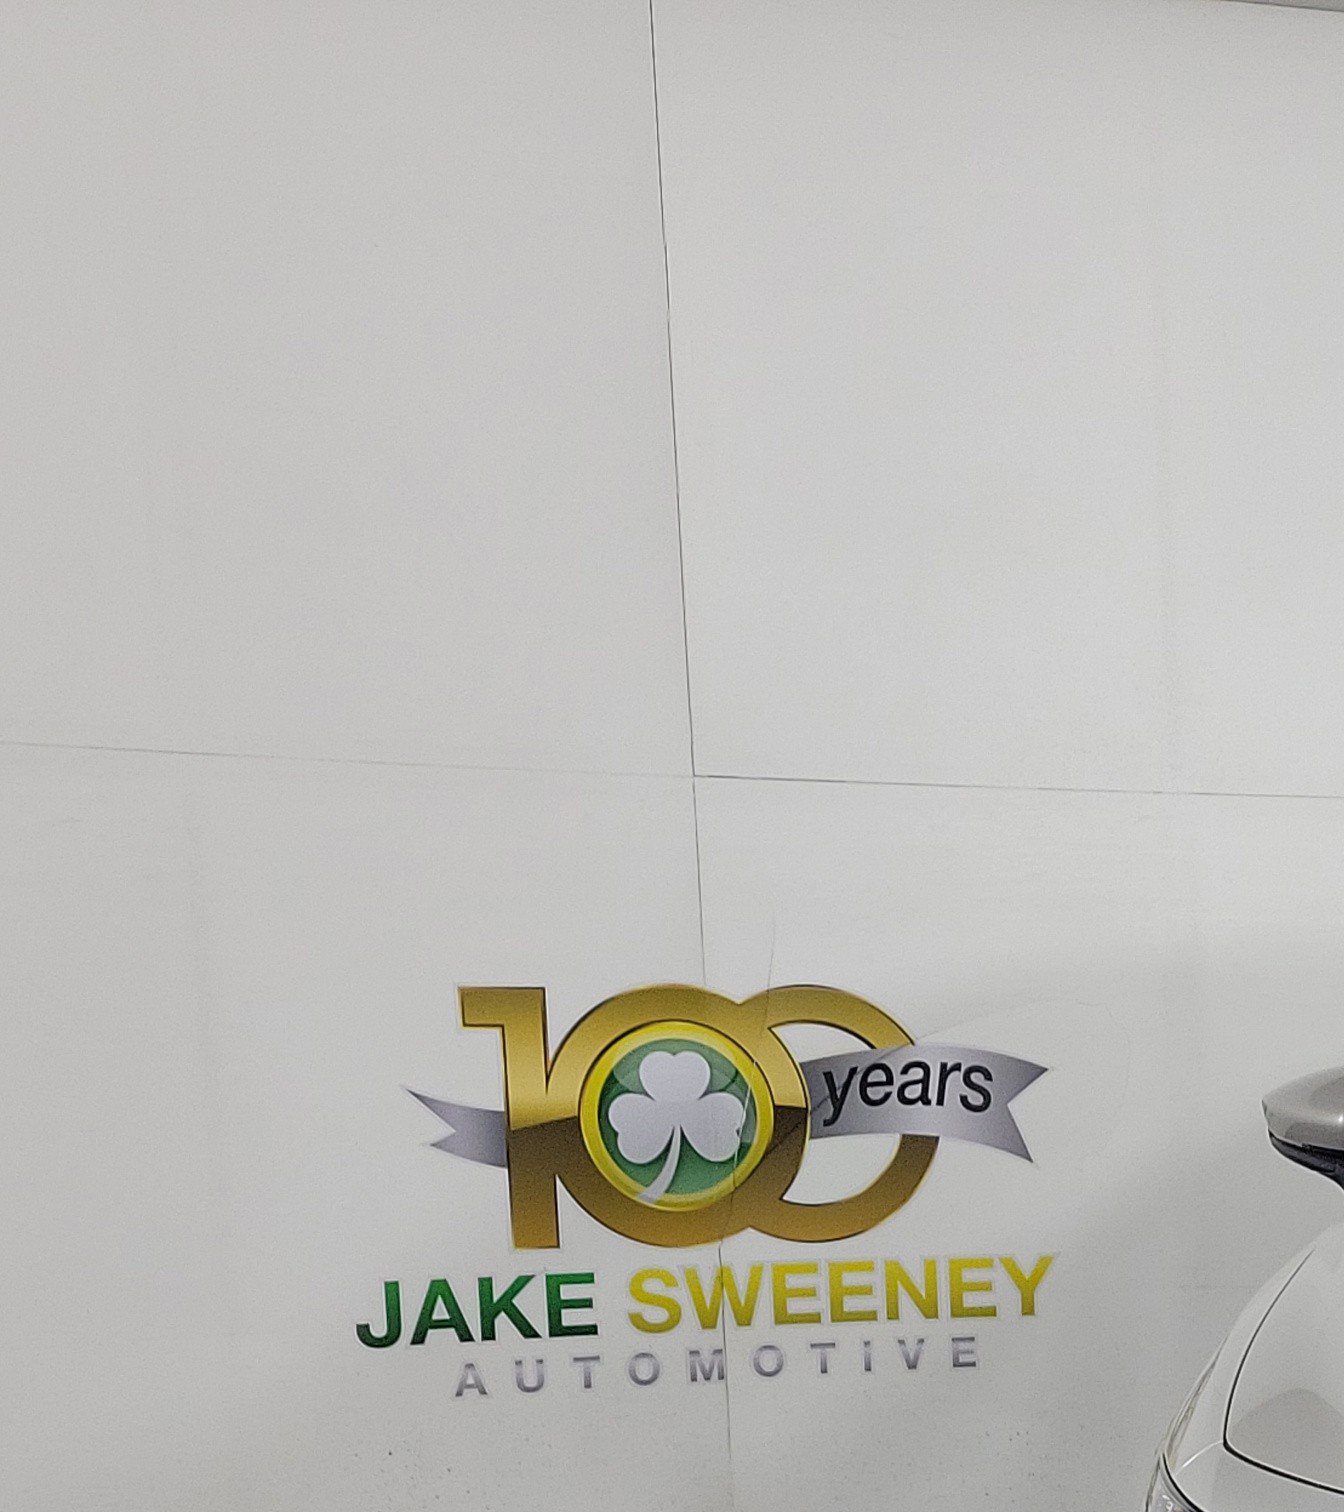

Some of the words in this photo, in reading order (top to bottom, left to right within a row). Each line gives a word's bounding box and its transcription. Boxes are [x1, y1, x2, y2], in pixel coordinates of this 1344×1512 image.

[822, 1060, 994, 1126] years
[356, 1271, 600, 1349] JAKE
[627, 1256, 1055, 1334] SWEENEY
[455, 1336, 980, 1398] AUTOMOTIVE
